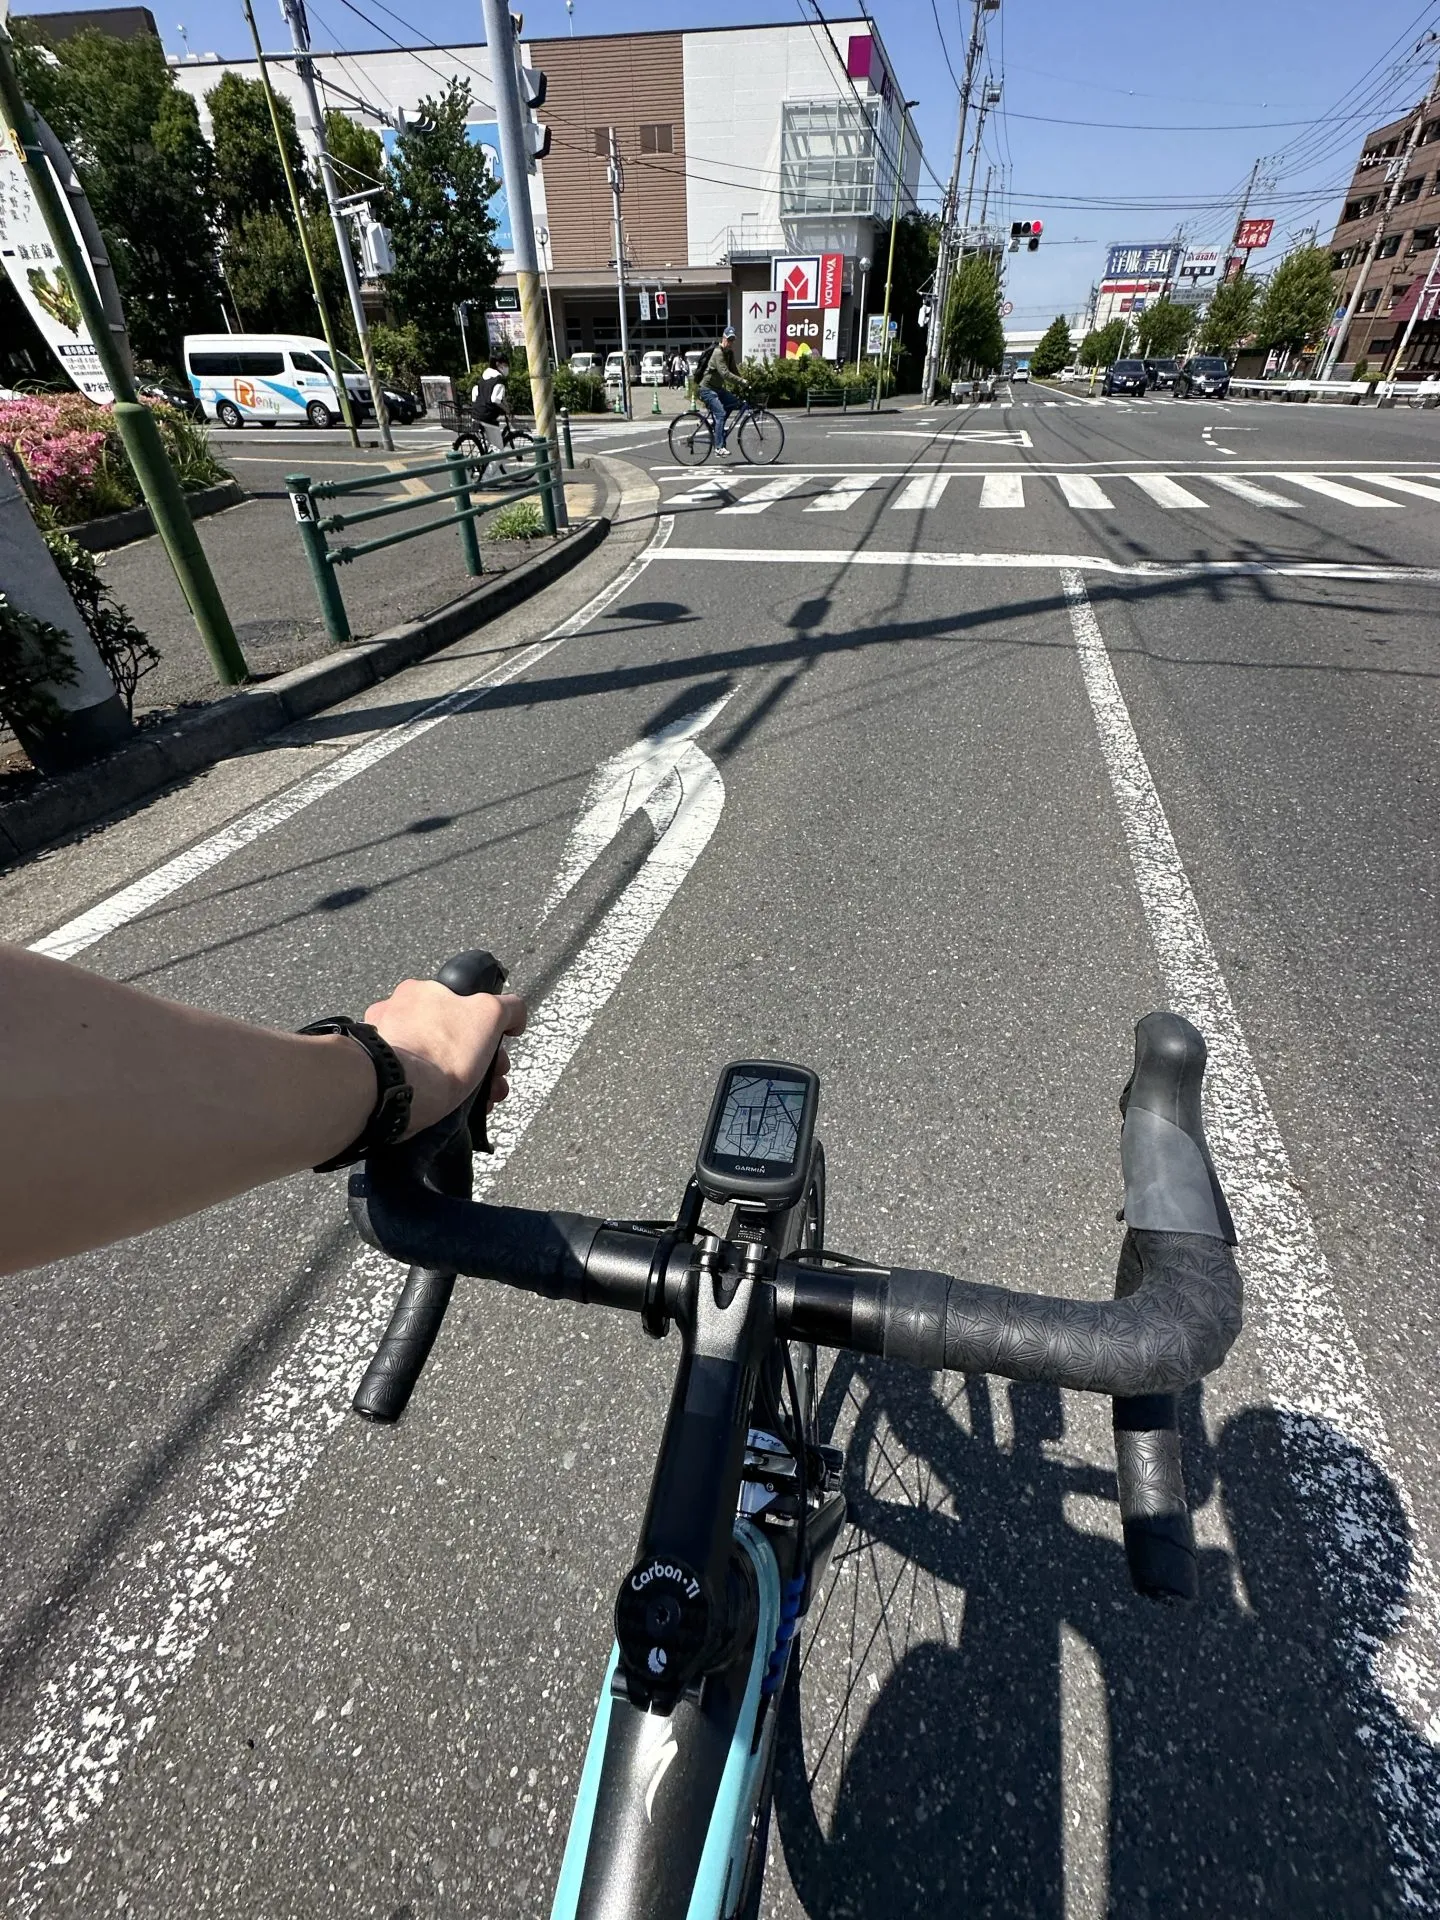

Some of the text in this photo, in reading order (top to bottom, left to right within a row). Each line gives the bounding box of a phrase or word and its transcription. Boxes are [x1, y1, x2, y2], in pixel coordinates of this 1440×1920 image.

[1241, 223, 1271, 234] ラーメン
[1237, 233, 1268, 245] 山岡家
[17, 243, 55, 260] 鎌産鎌
[1111, 249, 1172, 274] 洋服の青山
[824, 257, 836, 306] YAMADA
[766, 301, 777, 319] P
[786, 318, 819, 337] eria
[825, 329, 836, 340] 2F
[234, 378, 280, 415] Renty
[734, 1164, 766, 1174] GARMIN
